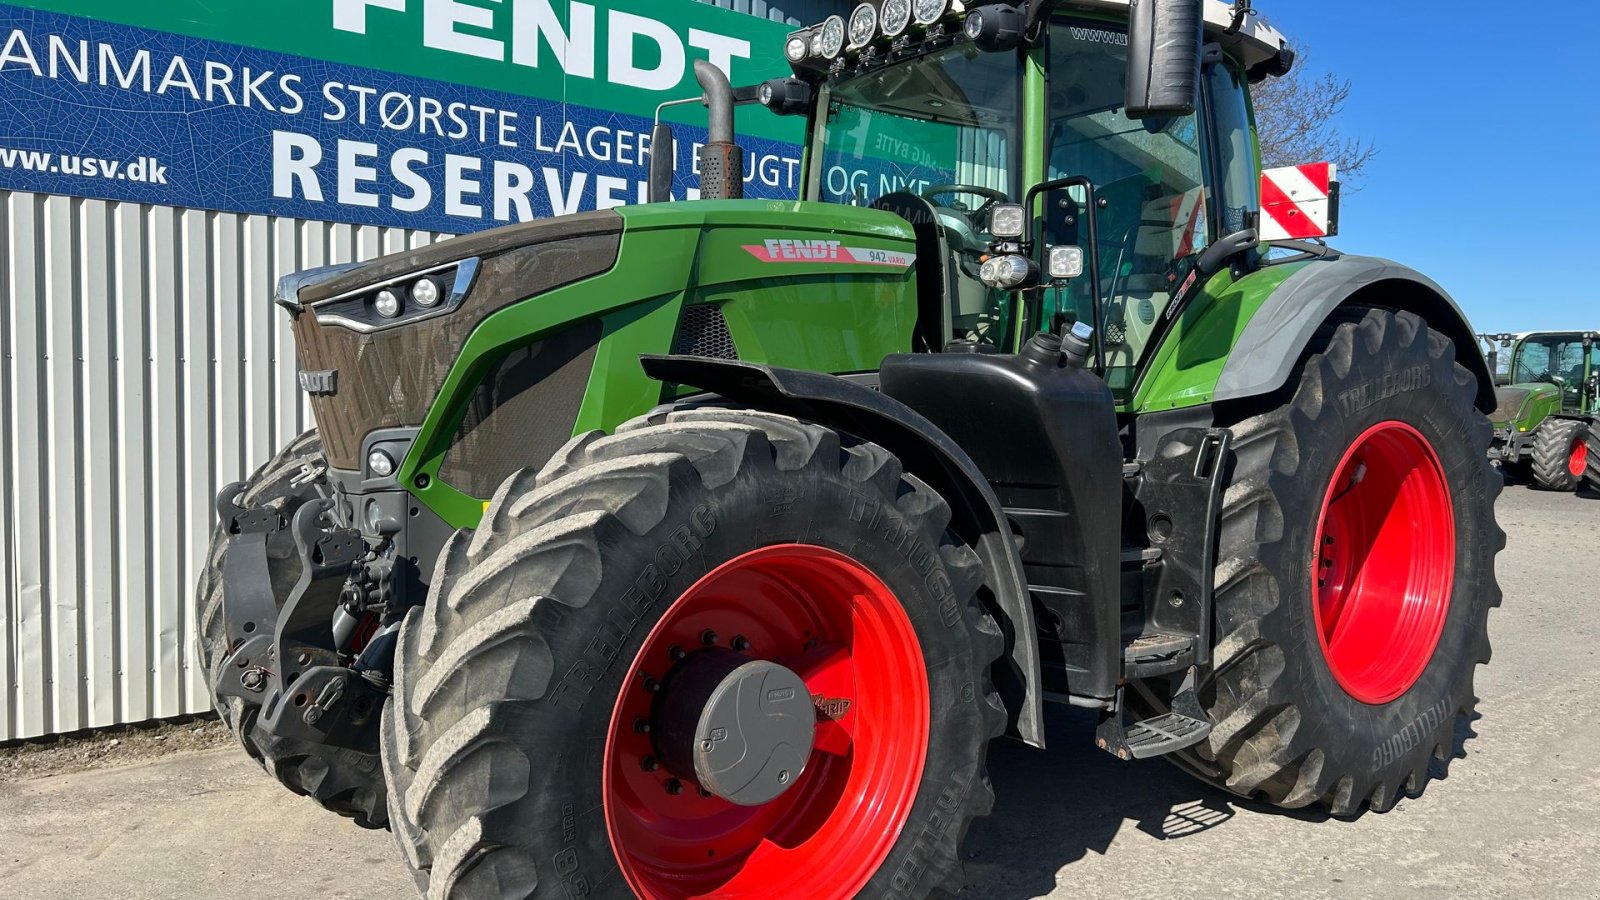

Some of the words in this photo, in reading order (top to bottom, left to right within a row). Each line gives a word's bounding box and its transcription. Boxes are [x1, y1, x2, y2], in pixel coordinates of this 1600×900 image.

[1070, 26, 1129, 46] www.u
[323, 82, 518, 142] STØRSTE
[827, 165, 868, 199] OG
[763, 238, 841, 259] FENDT
[869, 250, 887, 263] 942
[1337, 363, 1432, 418] TRELLEBORG
[548, 503, 718, 713] TRELLEBORG
